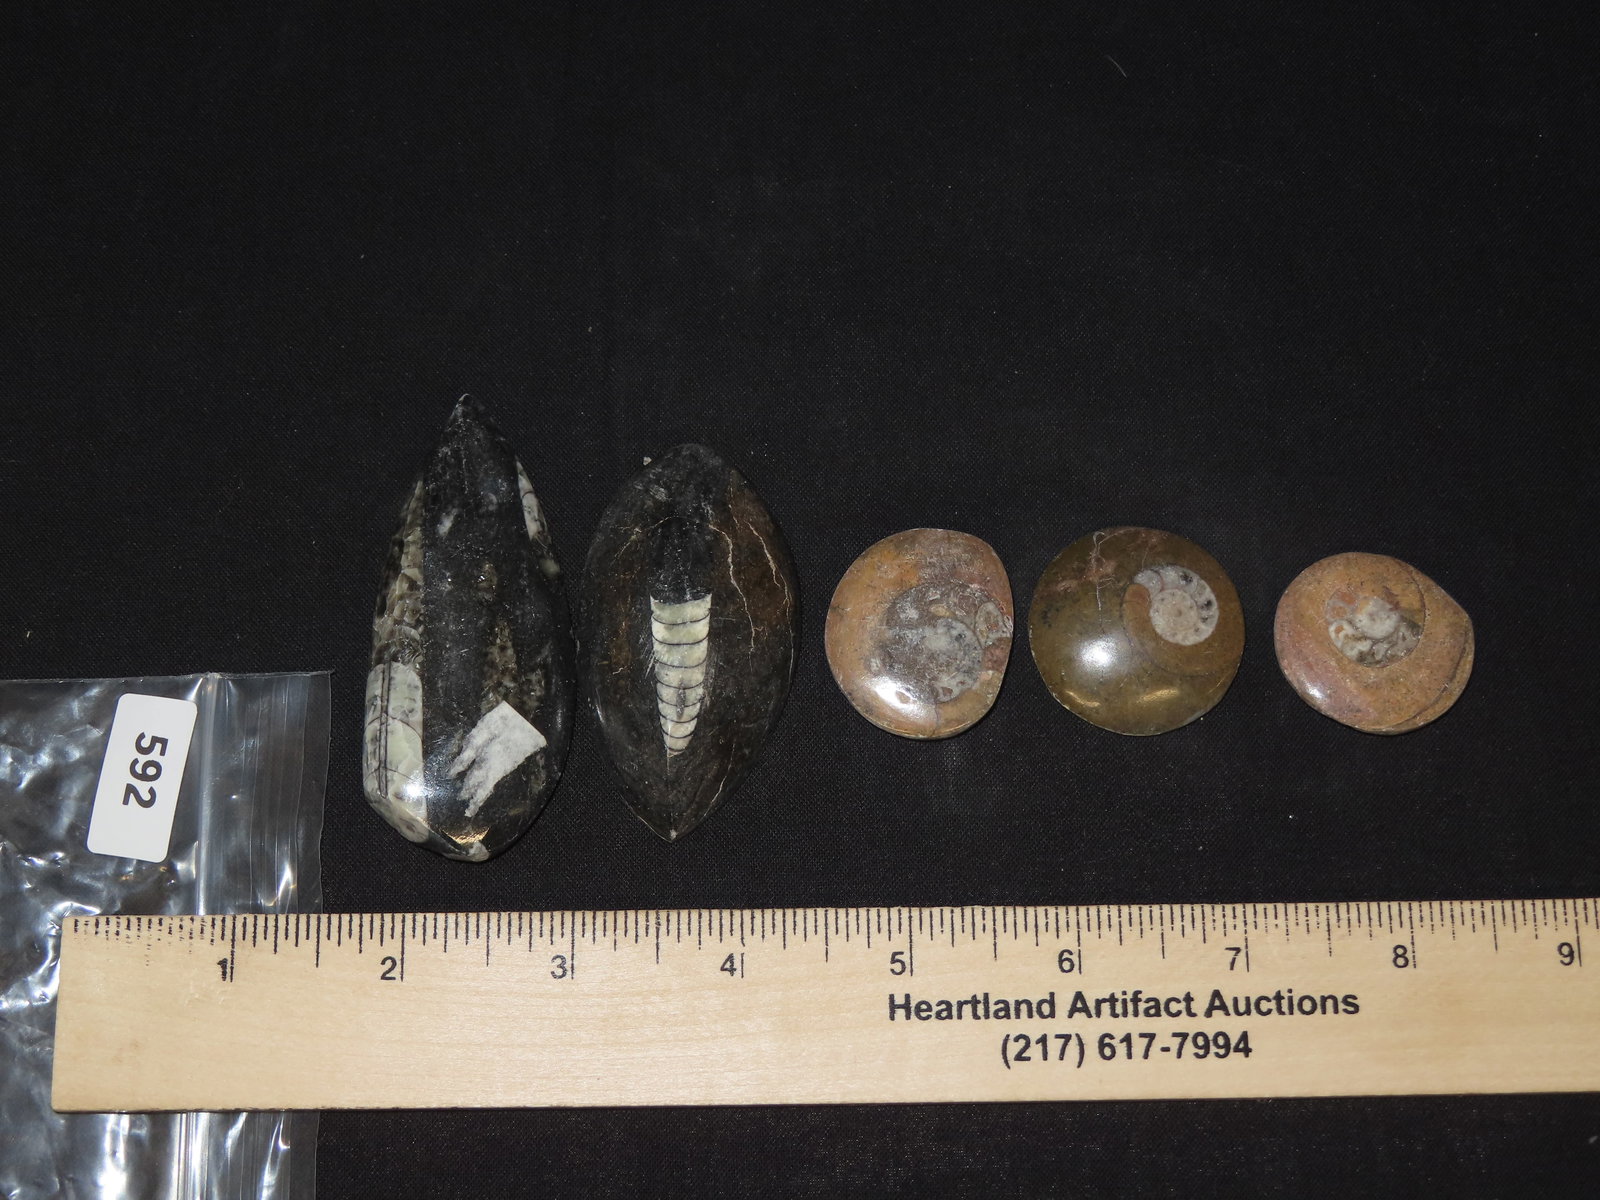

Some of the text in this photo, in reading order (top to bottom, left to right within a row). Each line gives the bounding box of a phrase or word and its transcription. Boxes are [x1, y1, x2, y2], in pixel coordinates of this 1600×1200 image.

[123, 732, 169, 809] 592
[217, 942, 1575, 981] 1 2 3 4 5 6 7 8 9
[889, 989, 1359, 1021] Heartland Artifact Auctions
[1002, 1031, 1252, 1069] (217) 617-7994
